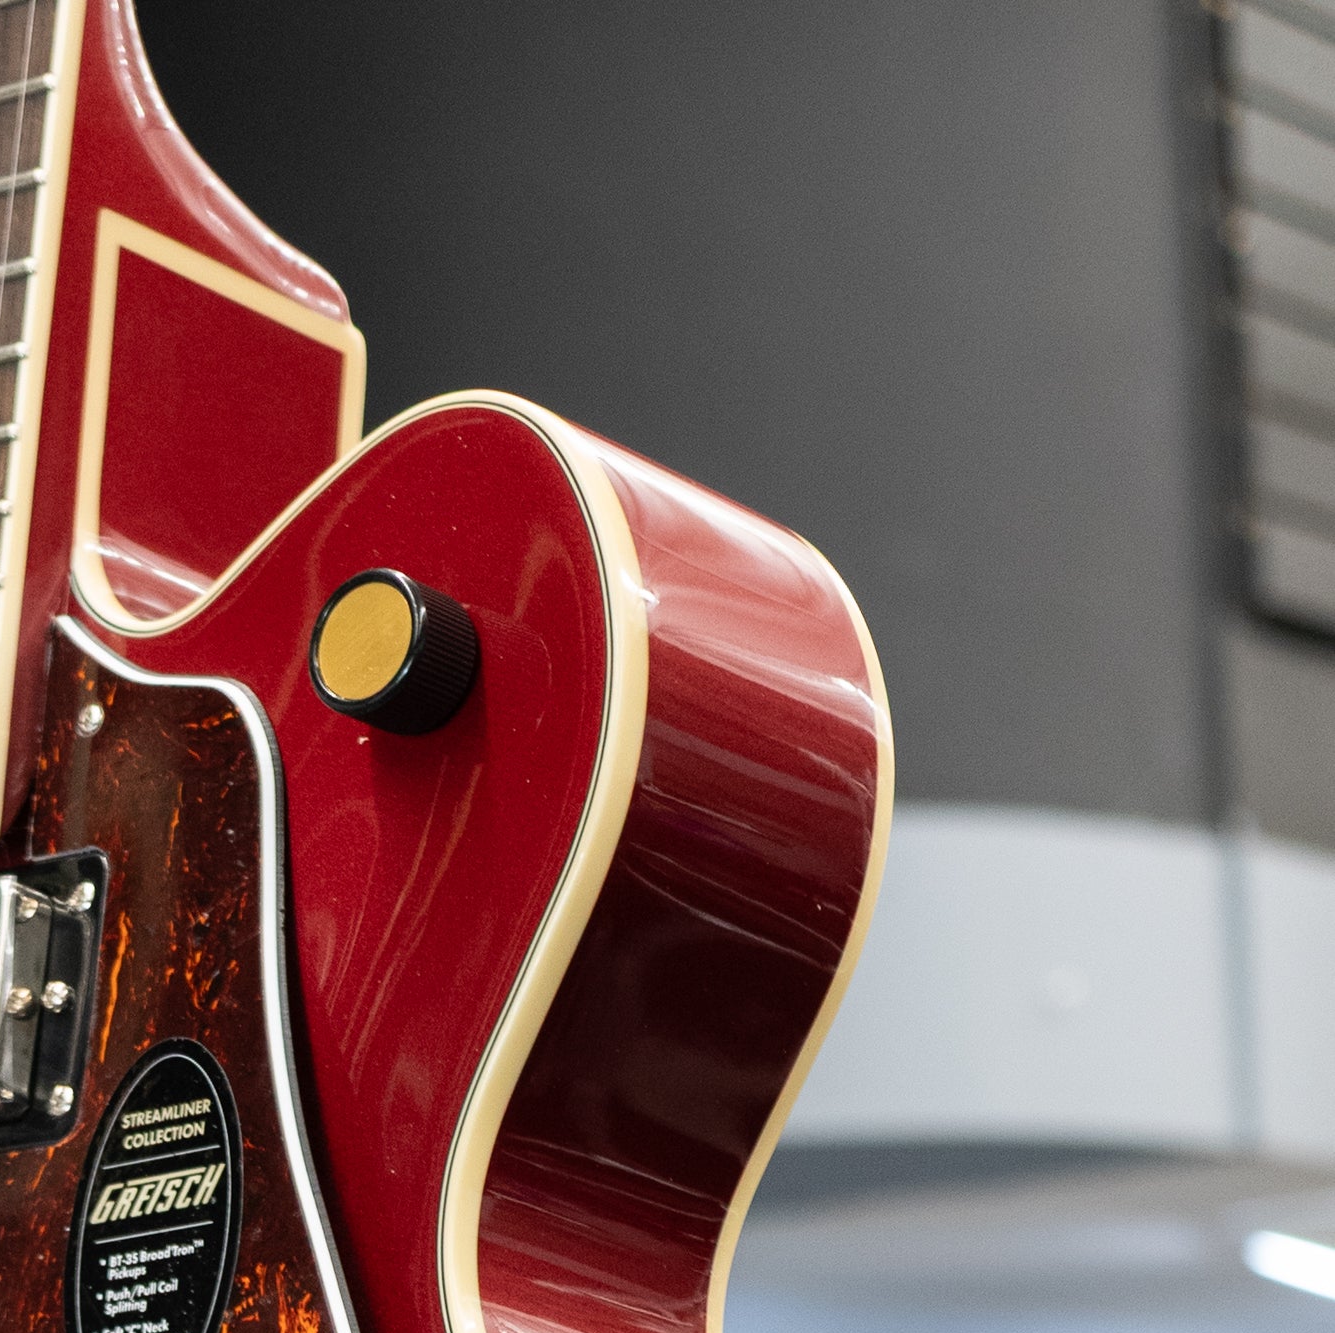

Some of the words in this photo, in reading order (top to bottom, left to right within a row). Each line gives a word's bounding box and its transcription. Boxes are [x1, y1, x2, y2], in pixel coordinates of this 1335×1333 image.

[121, 1099, 211, 1129] STREAMLINER
[123, 1121, 206, 1150] COLLECTION
[89, 1163, 226, 1225] GRETSCH
[107, 1266, 146, 1280] Pickups
[106, 1282, 157, 1302] Push/Pull
[158, 1278, 179, 1293] Coil
[104, 1300, 147, 1317] Splitting
[142, 1318, 169, 1333] Neck
